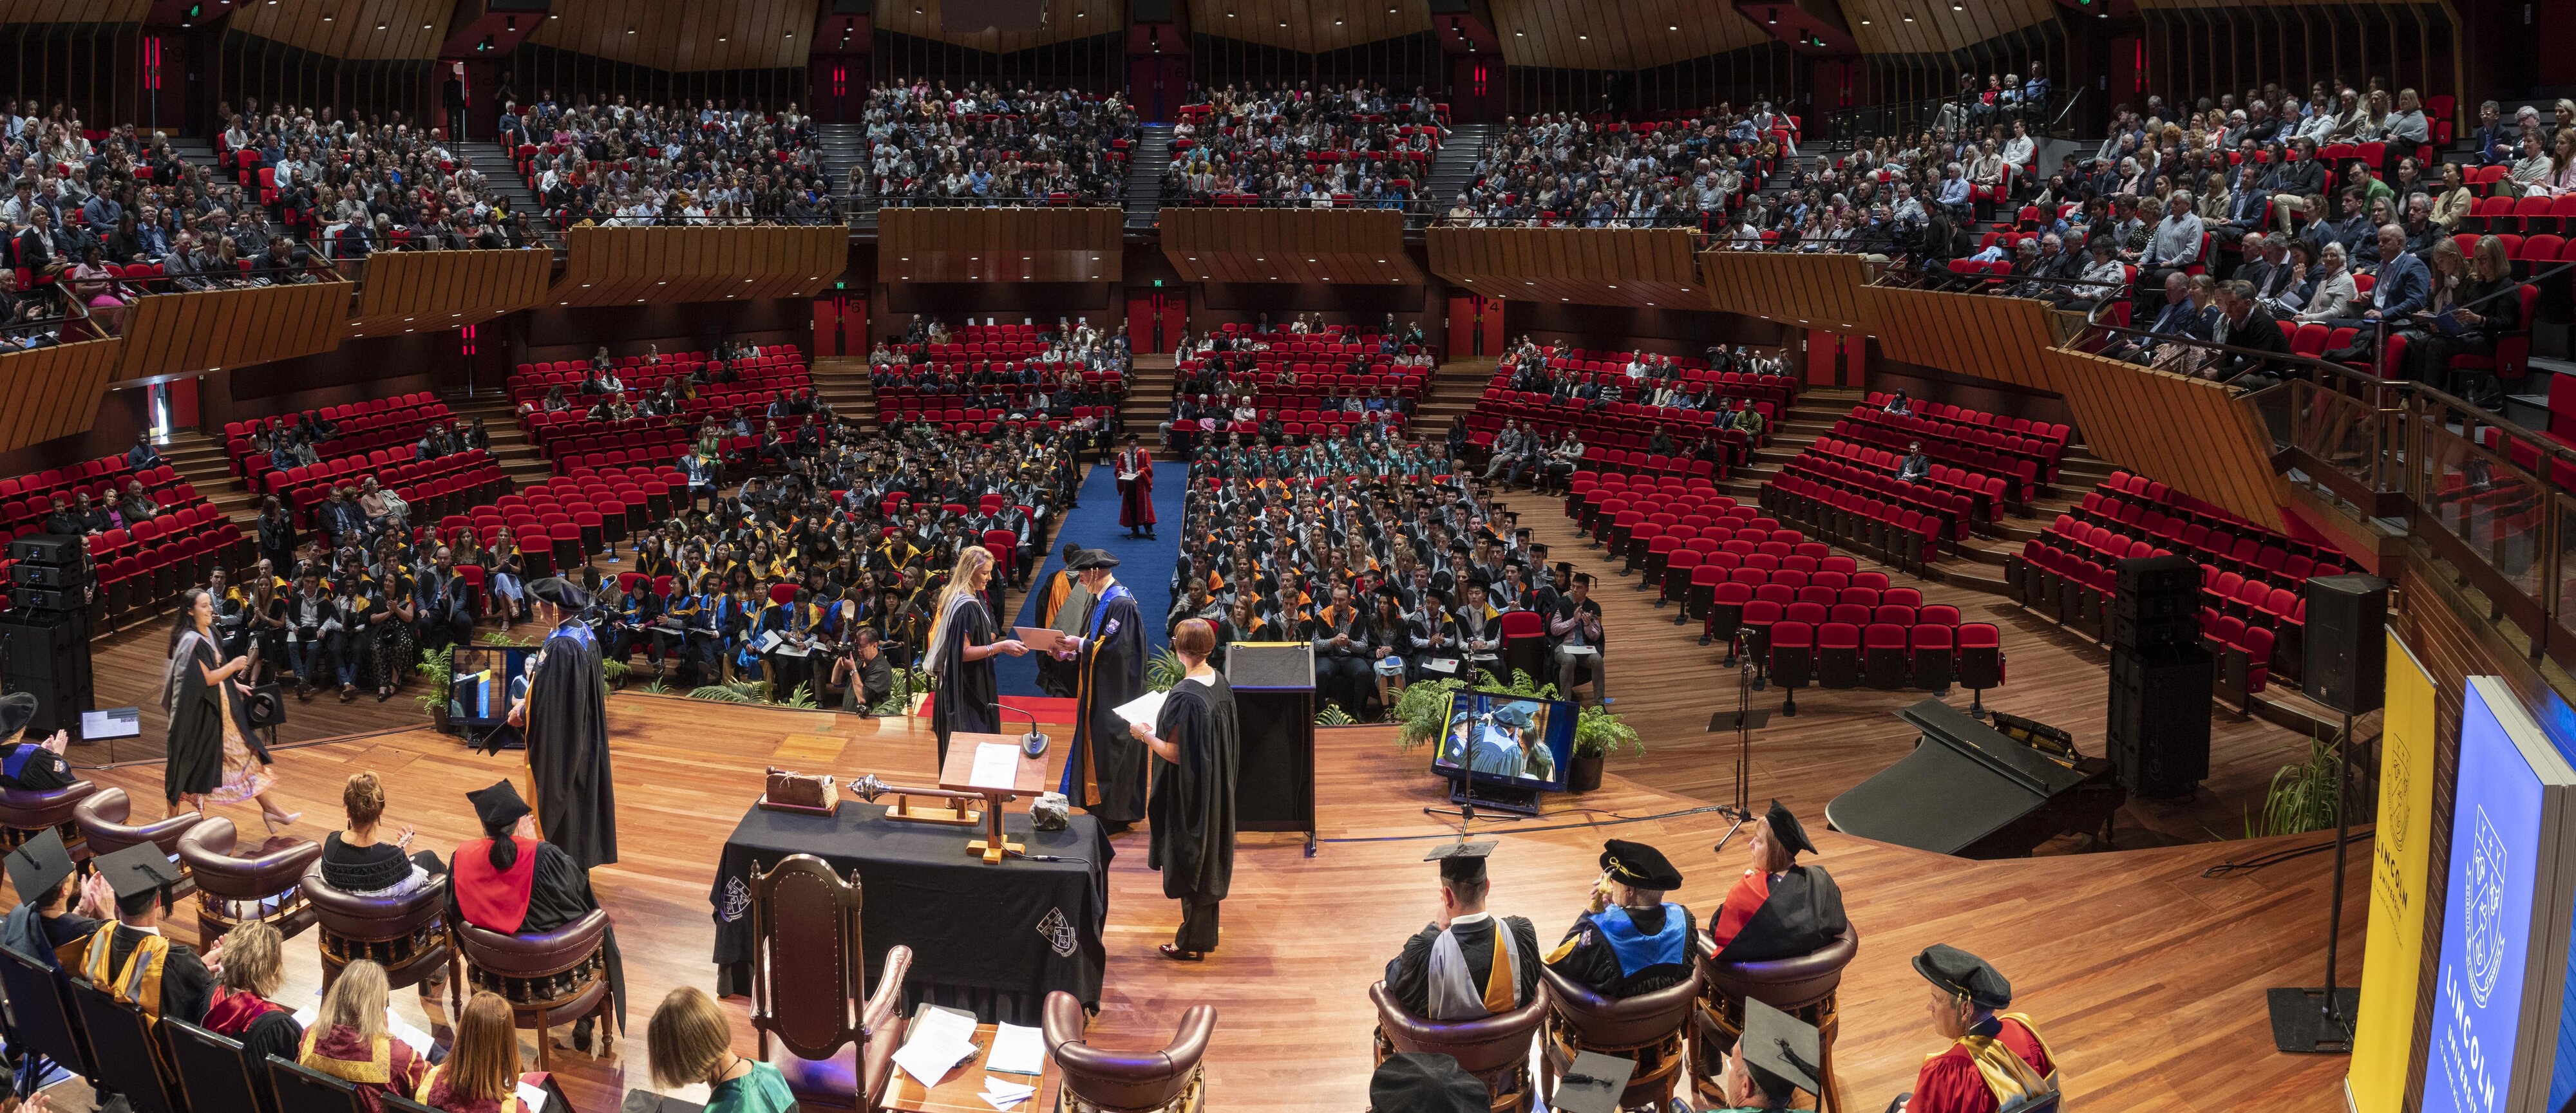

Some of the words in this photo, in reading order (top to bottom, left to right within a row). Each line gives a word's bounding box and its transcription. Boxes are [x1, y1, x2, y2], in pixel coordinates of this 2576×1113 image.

[847, 67, 862, 78] 17
[1166, 66, 1184, 78] 16
[851, 302, 860, 313] 6
[1170, 299, 1179, 310] 5
[1489, 302, 1500, 313] 4
[2376, 834, 2407, 911] LINCOLN
[2379, 869, 2401, 922] UNIVERSITY
[2447, 964, 2494, 1113] LINCOLN
[2439, 1038, 2444, 1055] TE
[2443, 1052, 2454, 1089] WHARE
[2448, 1024, 2478, 1113] UNIVERSIT
